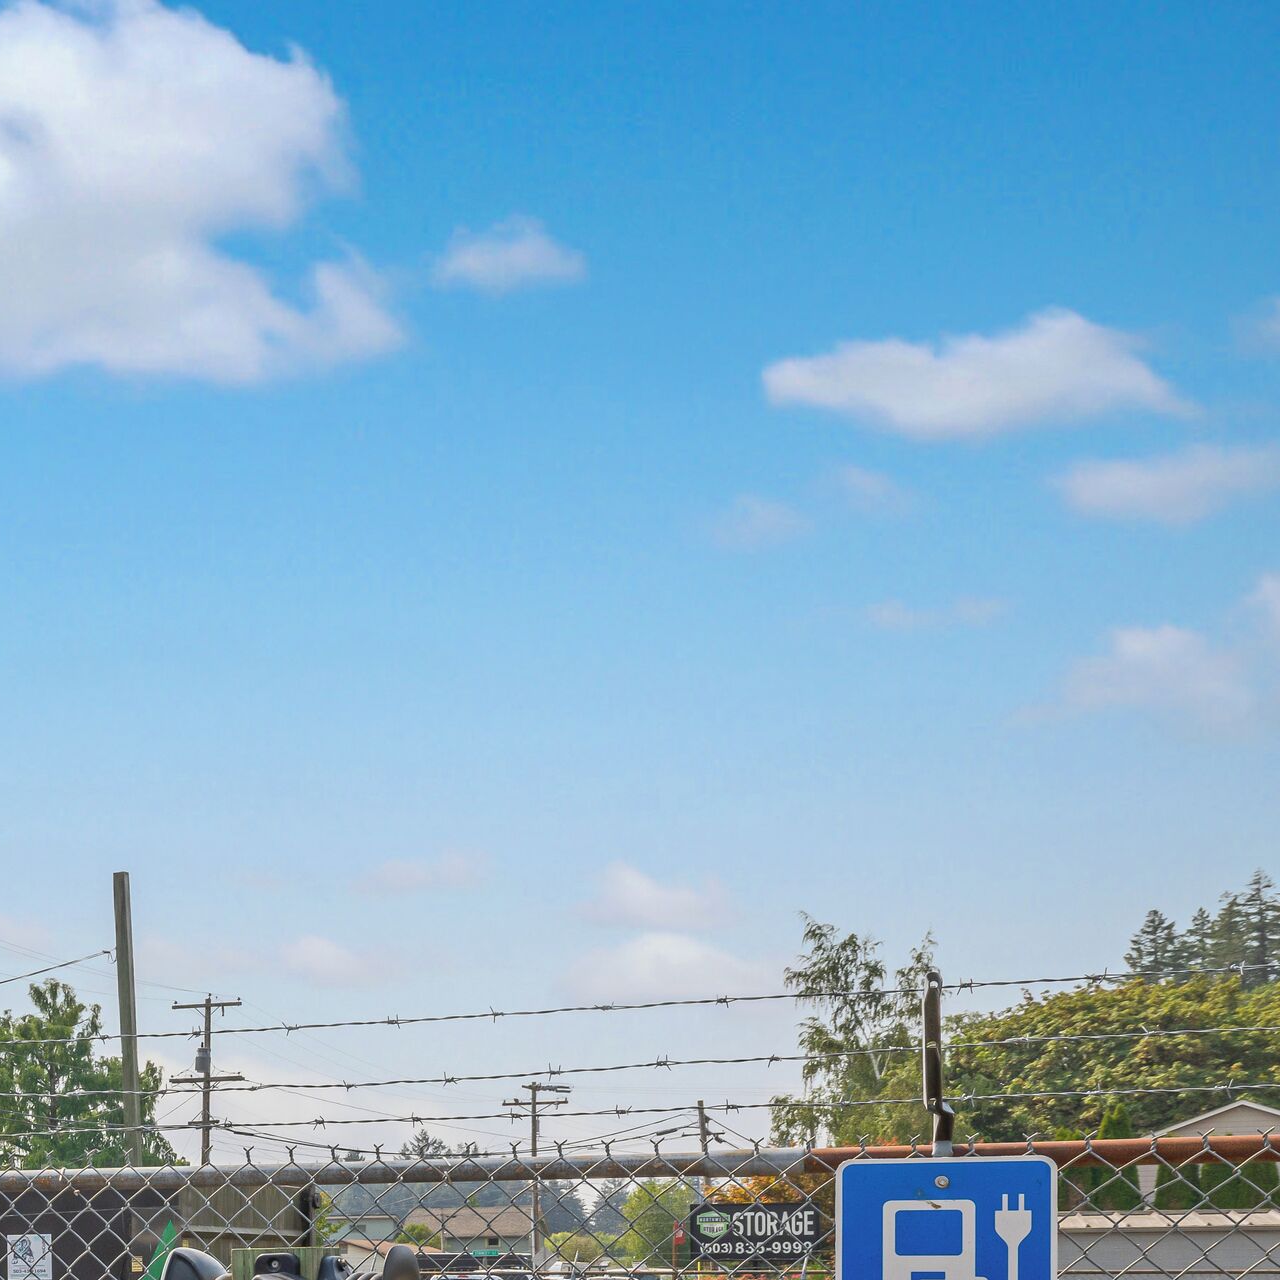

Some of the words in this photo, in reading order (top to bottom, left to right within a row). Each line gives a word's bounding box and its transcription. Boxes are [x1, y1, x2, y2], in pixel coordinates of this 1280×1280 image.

[732, 1210, 815, 1237] STORAGE
[699, 1242, 733, 1254] (503)
[735, 1241, 813, 1254] 835-9999
